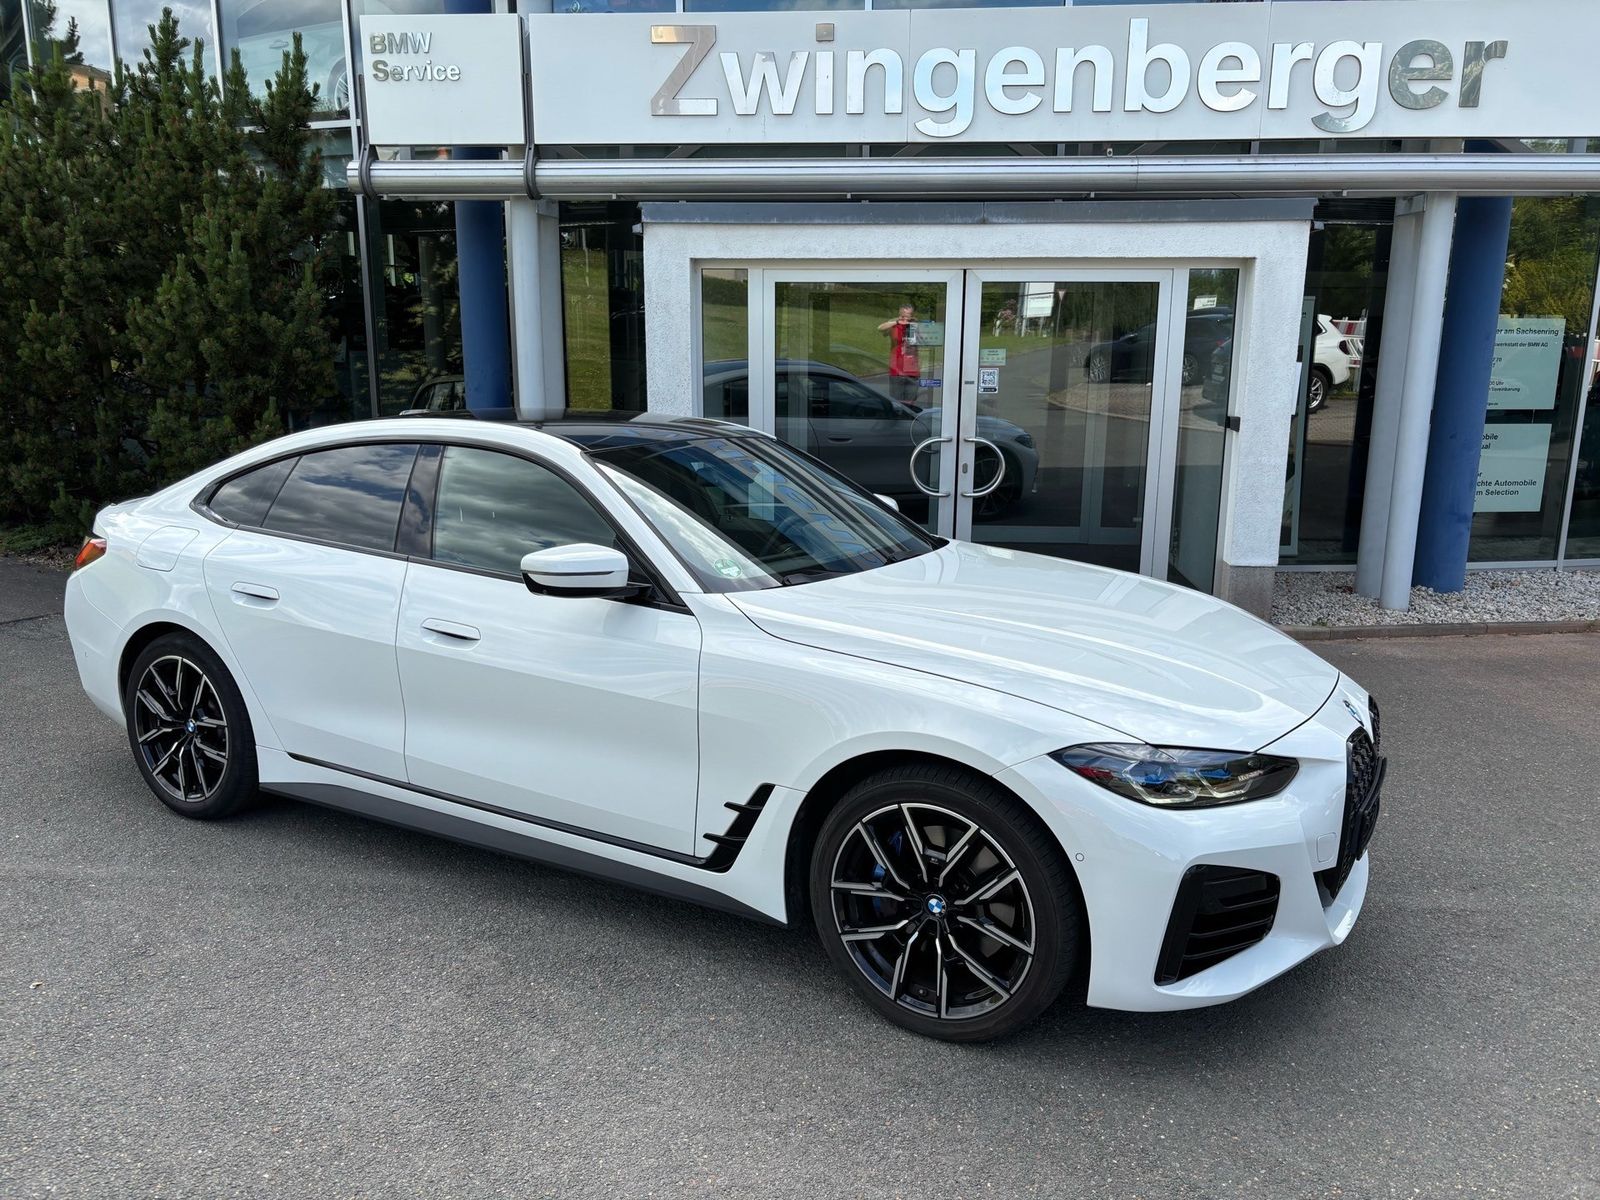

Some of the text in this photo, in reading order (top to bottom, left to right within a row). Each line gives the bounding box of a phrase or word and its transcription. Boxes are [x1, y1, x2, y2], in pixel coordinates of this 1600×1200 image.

[369, 31, 432, 54] BMW
[372, 59, 461, 81] Service
[650, 17, 1508, 138] Zwingenberger
[1516, 327, 1559, 336] Sachsenring
